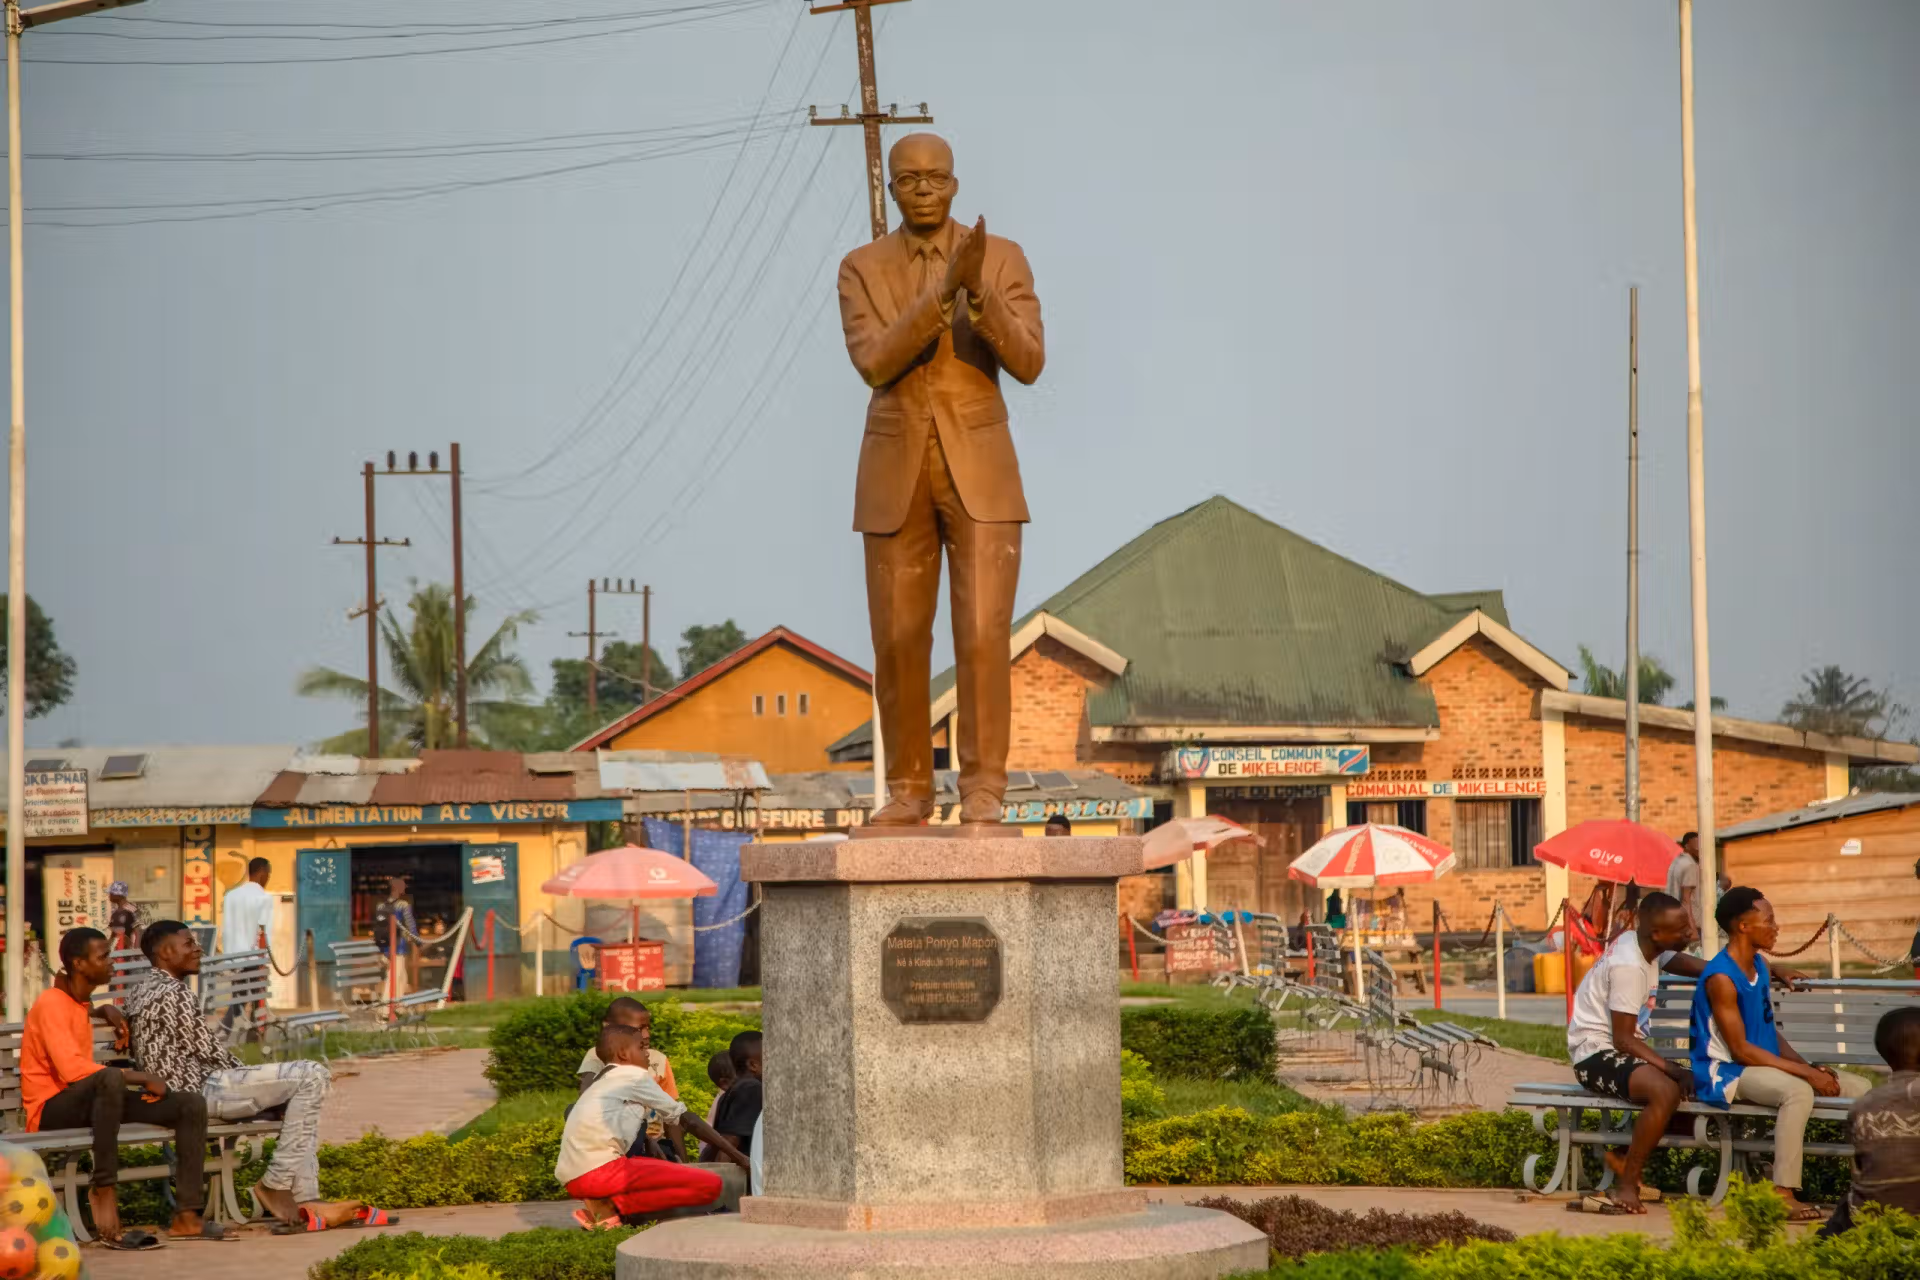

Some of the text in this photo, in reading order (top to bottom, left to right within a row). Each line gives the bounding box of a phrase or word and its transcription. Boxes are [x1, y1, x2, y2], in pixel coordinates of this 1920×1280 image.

[1212, 749, 1266, 761] CONSEIL
[1218, 763, 1237, 774] DE
[1346, 784, 1428, 796] COMMUNAL
[1433, 783, 1453, 794] DE
[284, 805, 423, 826] ALIMENTATION
[489, 802, 569, 820] VICTOR
[836, 809, 864, 827] DU
[887, 937, 922, 949] Matata
[926, 936, 959, 950] Ponyo
